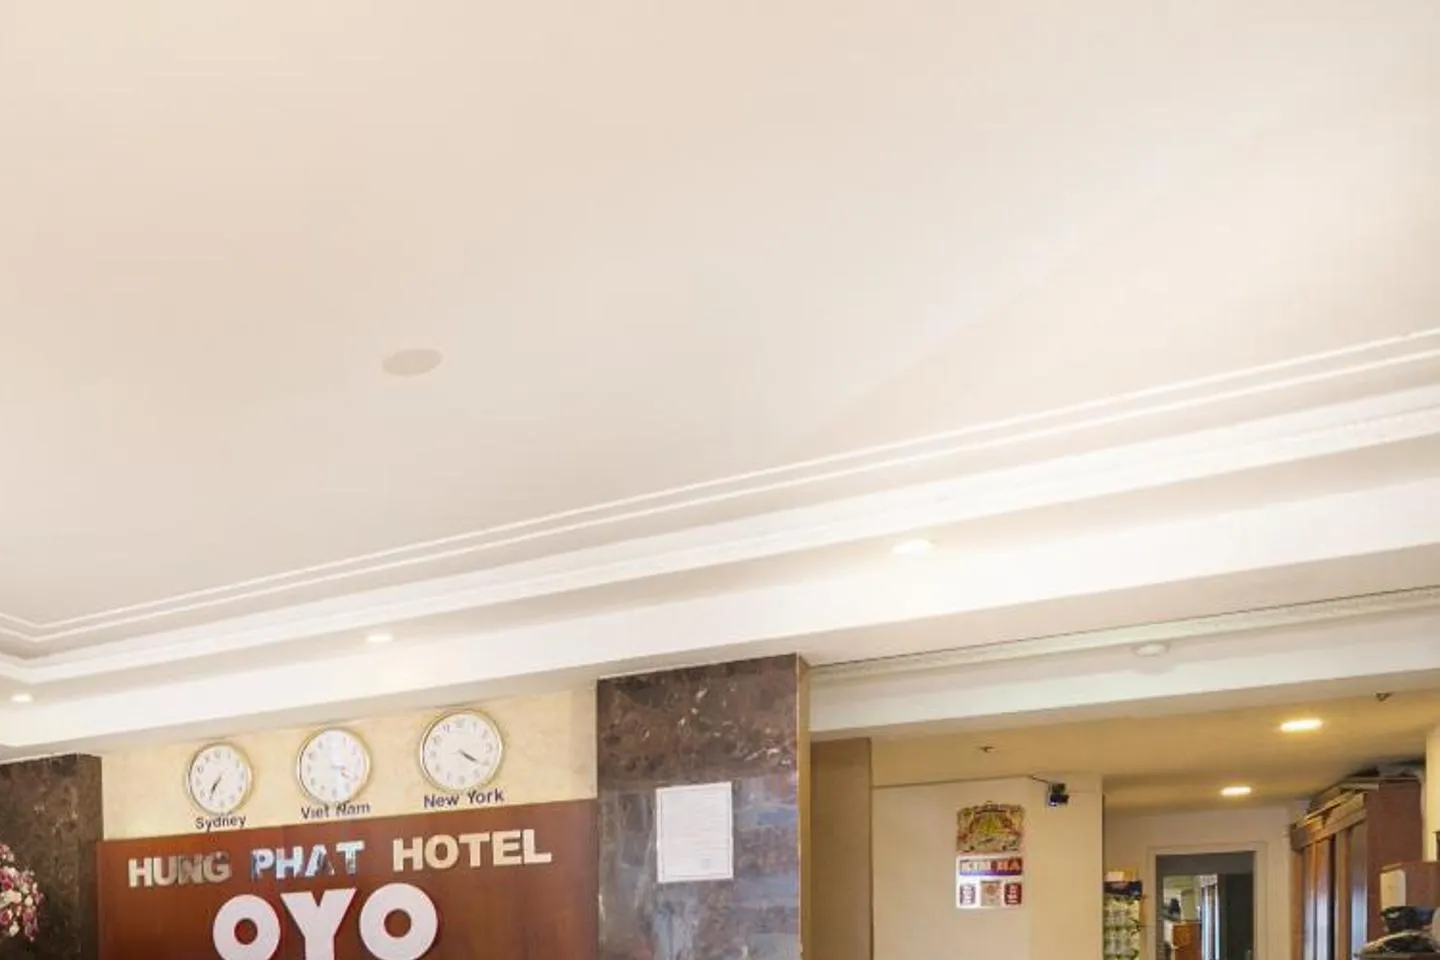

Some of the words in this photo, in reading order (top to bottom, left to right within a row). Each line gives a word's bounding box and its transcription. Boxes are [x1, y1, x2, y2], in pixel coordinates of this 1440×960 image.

[423, 793, 459, 808] New
[467, 788, 504, 804] York
[335, 801, 371, 816] Nam
[195, 814, 247, 832] Sydney
[127, 850, 232, 888] HUNG
[250, 840, 364, 880] PHAT
[392, 829, 552, 872] HOTEL
